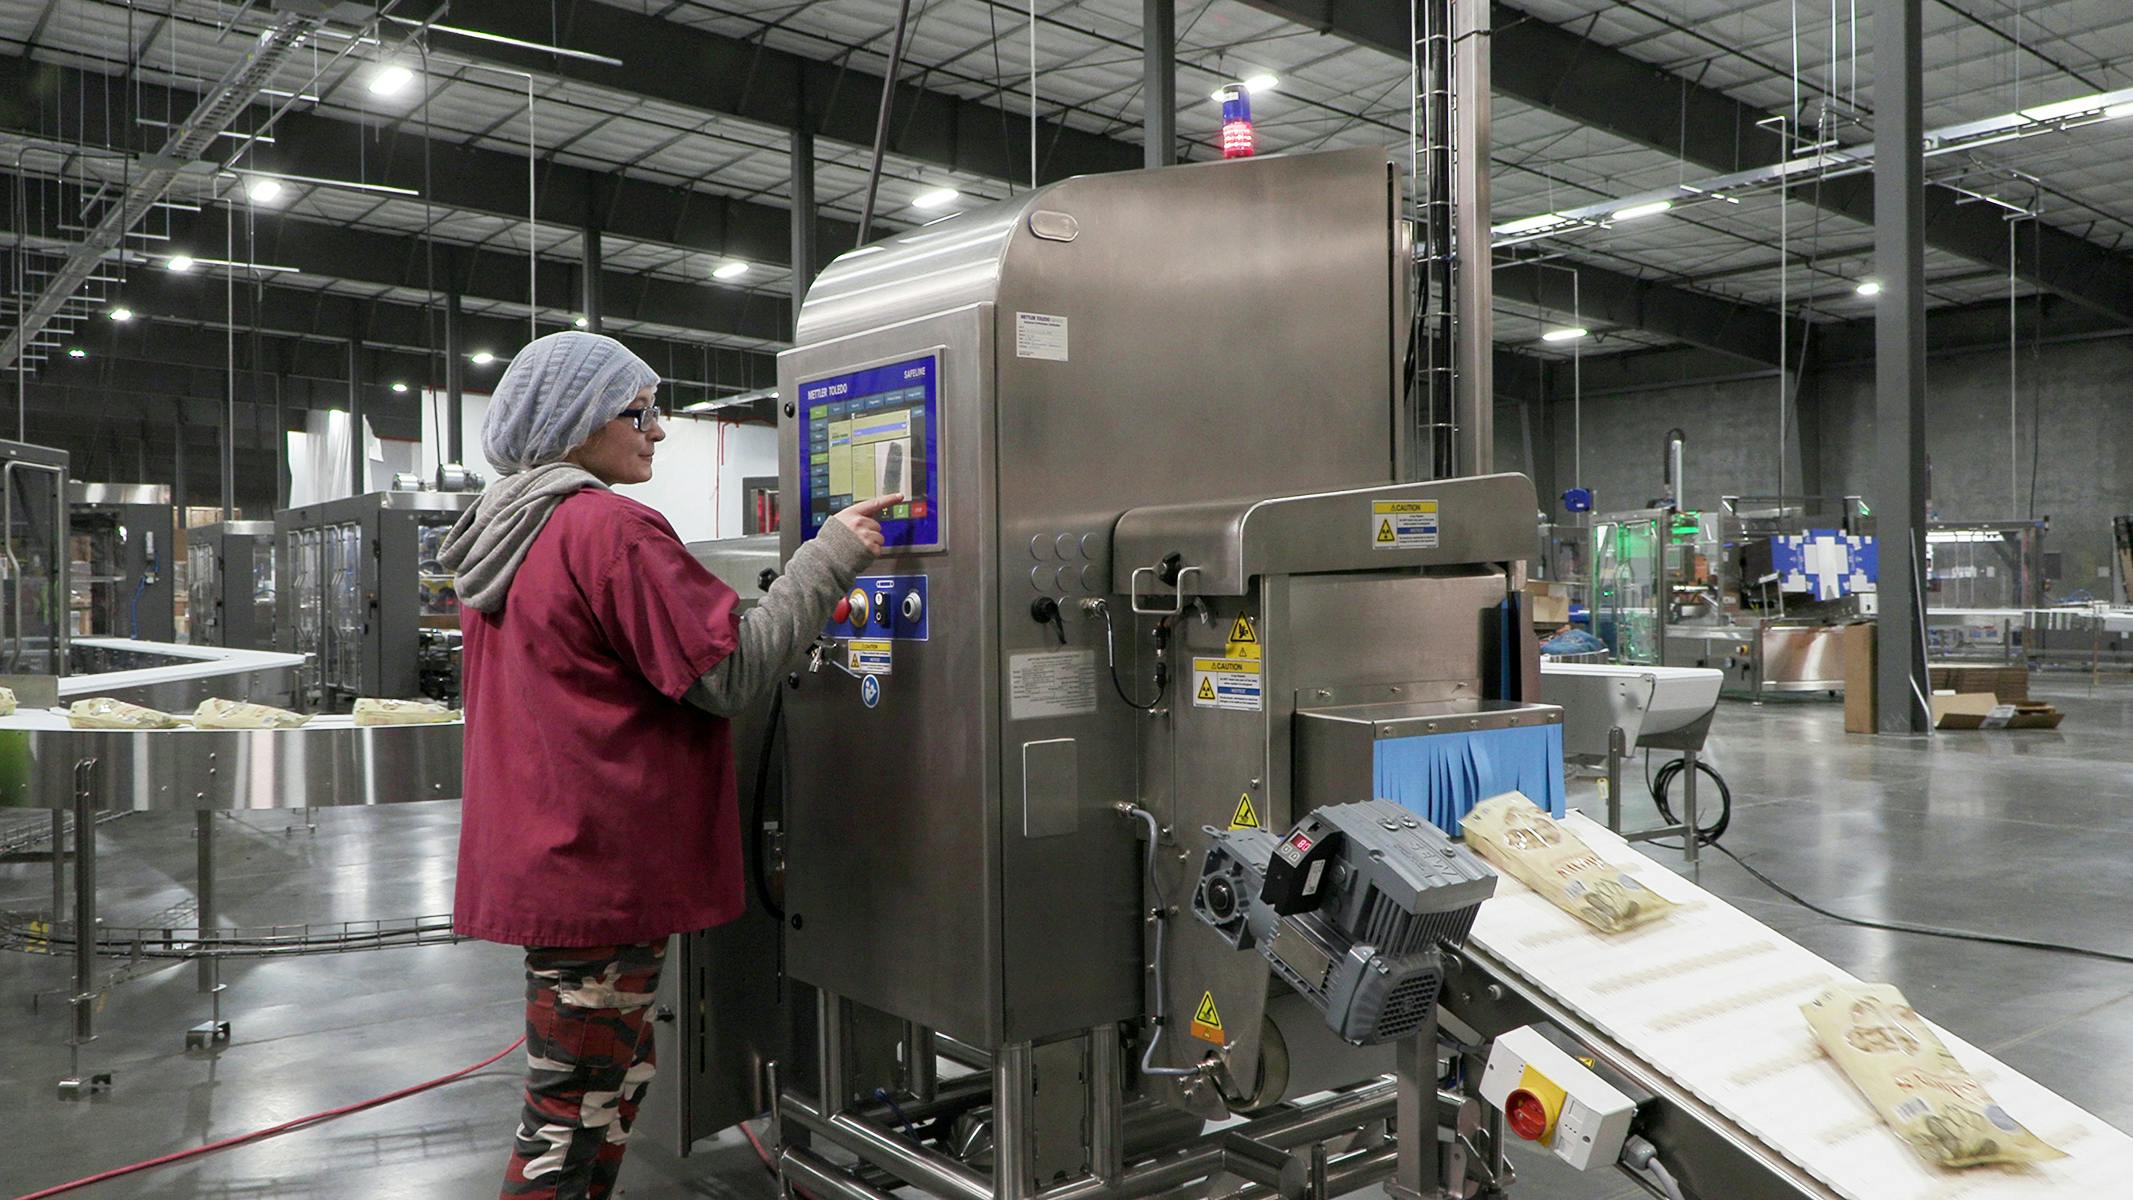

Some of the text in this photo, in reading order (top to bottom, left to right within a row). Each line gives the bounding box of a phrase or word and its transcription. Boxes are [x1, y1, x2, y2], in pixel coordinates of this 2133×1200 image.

[903, 367, 926, 379] SAFELINE
[807, 383, 848, 400] METTLER TOLEDO
[1217, 662, 1243, 671] CAUTION
[1297, 839, 1311, 852] 80
